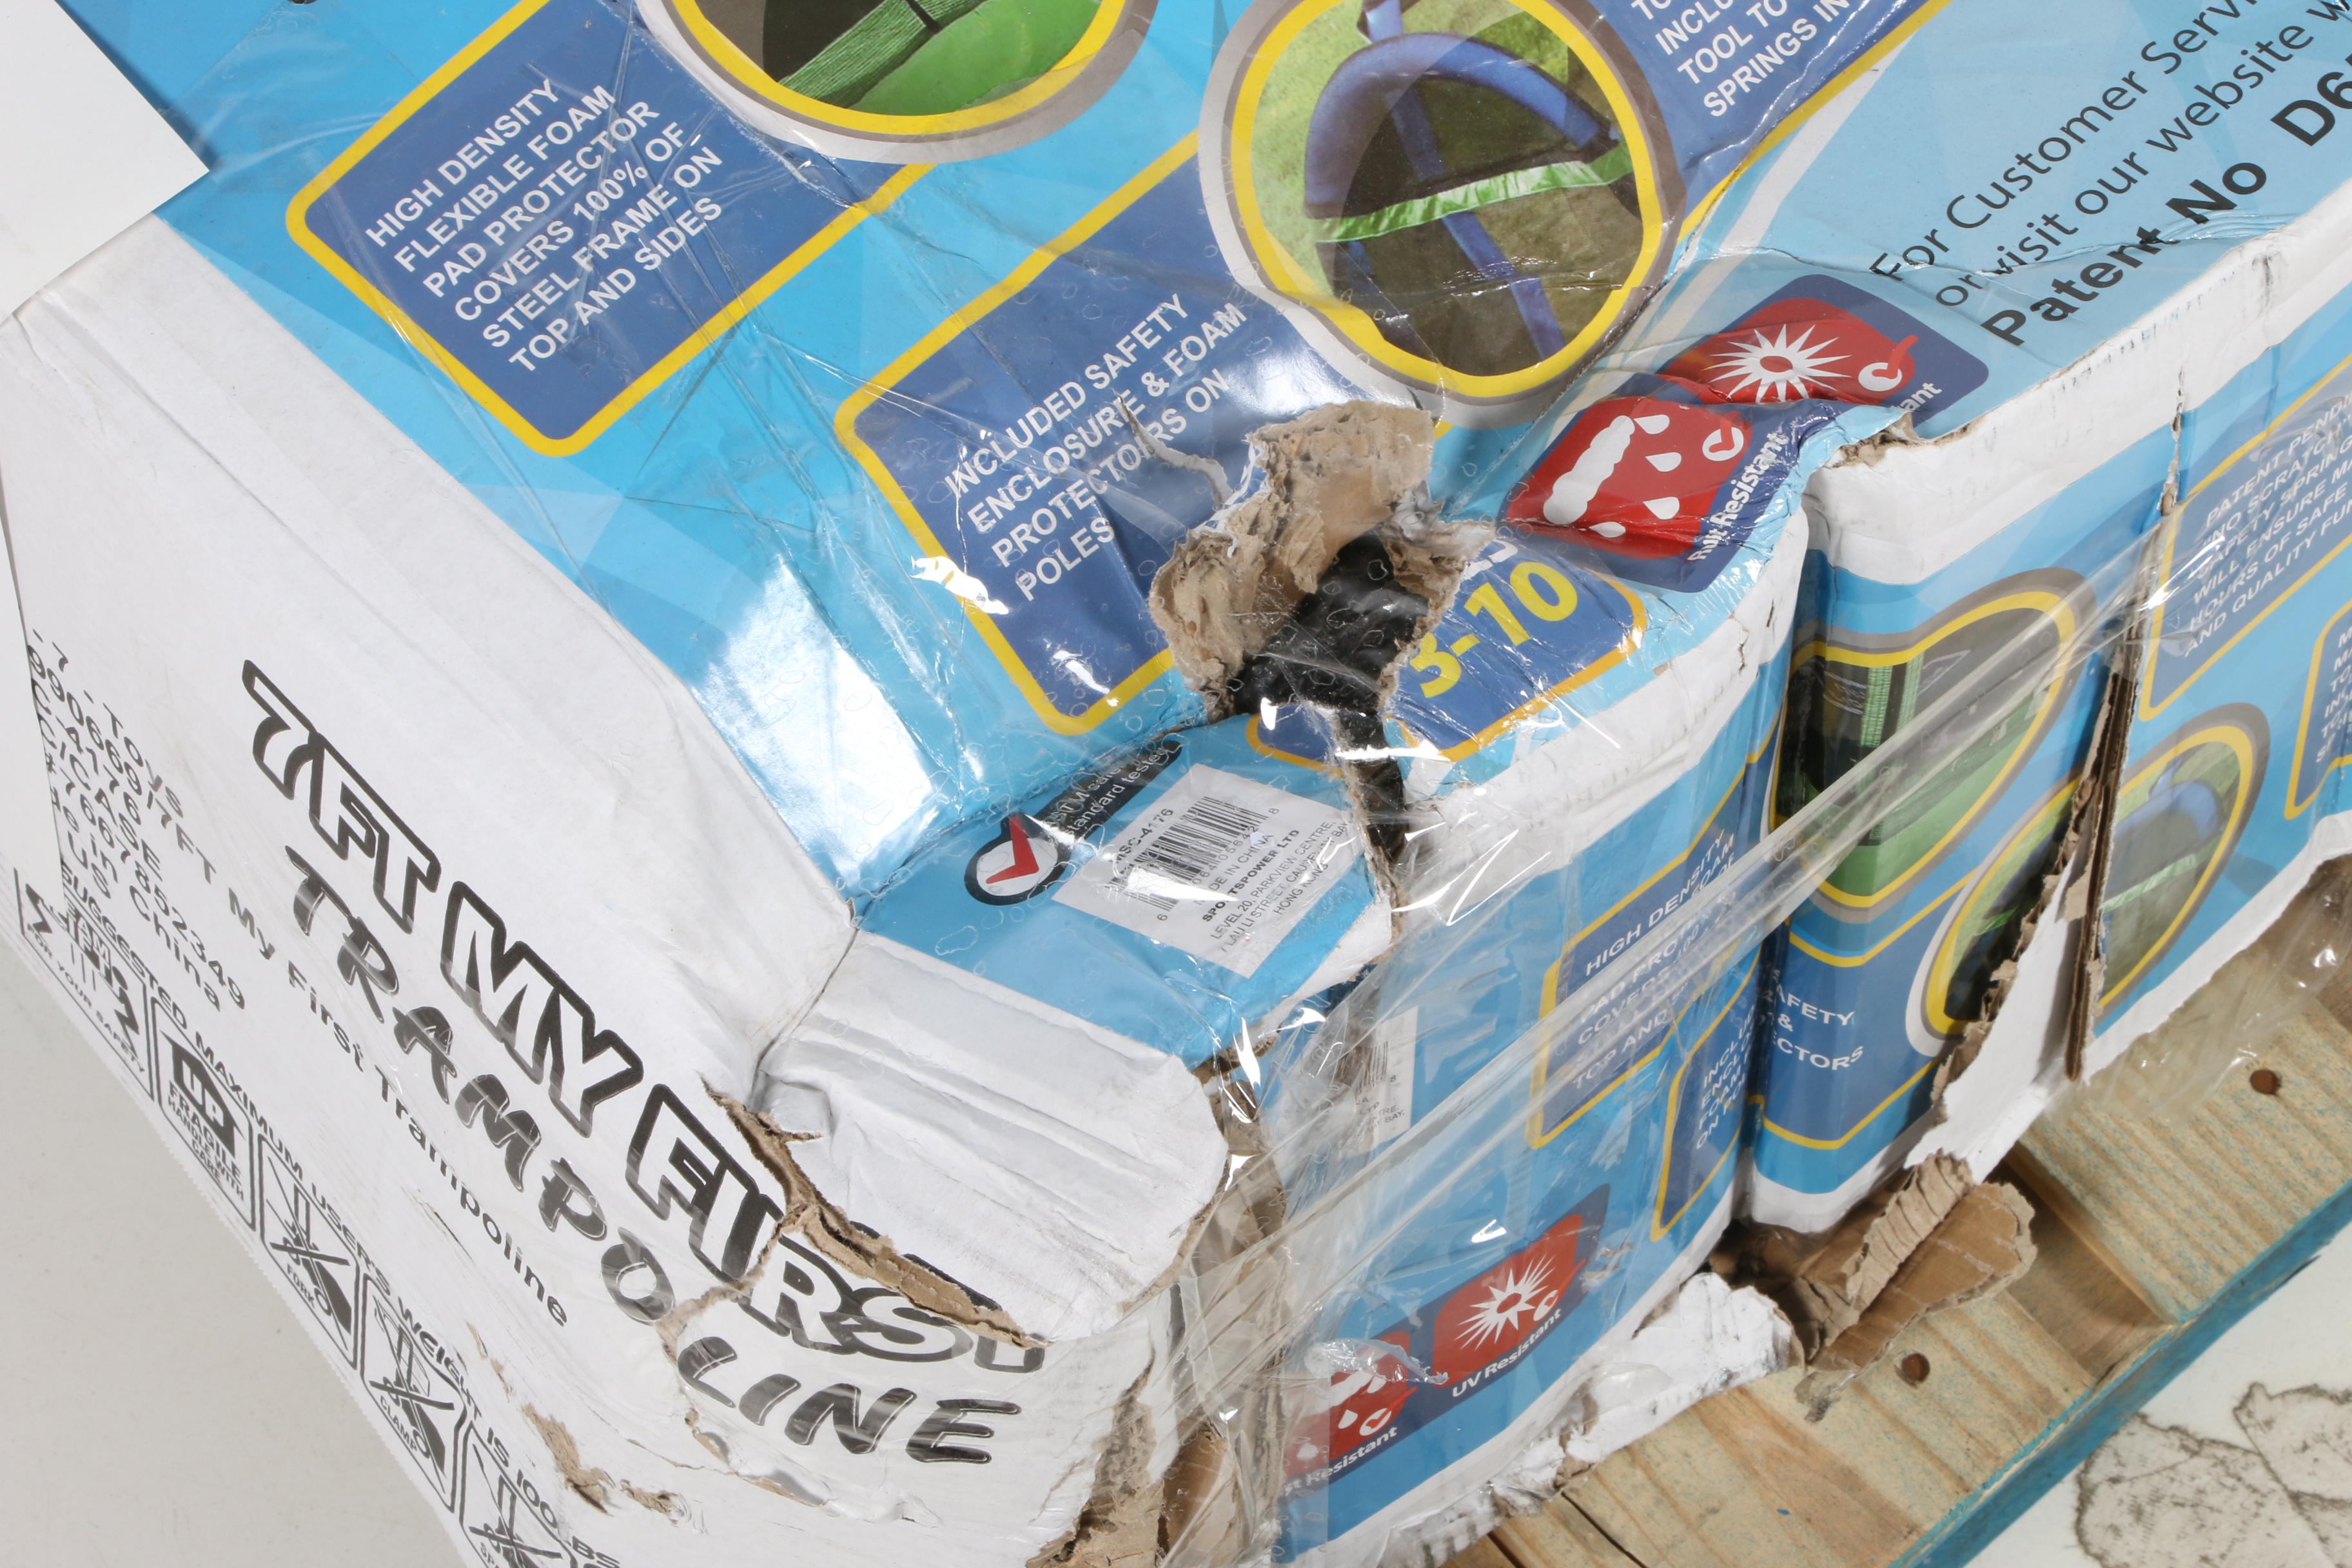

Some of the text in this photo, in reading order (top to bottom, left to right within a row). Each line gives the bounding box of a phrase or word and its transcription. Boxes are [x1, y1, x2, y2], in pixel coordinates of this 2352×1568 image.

[1677, 0, 1787, 84] TOOL TO
[1703, 19, 1817, 116] SPRINGS
[366, 79, 559, 246] HIGH DENSITY
[394, 85, 616, 272] FLEXIBLE FOAM
[423, 101, 660, 298] PAD PROTECTOR
[1870, 0, 2257, 281] For Customer Serv
[1936, 270, 1988, 307] or
[1988, 213, 2079, 274] visit
[2075, 152, 2149, 215] our
[2146, 26, 2314, 153] website
[1980, 54, 2352, 346] Patent No D6
[455, 122, 687, 321] COVERS 100% OF
[483, 146, 723, 348] STEEL FRAME ON
[509, 197, 722, 371] TOP AND SIDES
[945, 293, 1188, 498] INCLUDED SAFETY
[968, 302, 1247, 532] ENCLOSURE & FOAM
[992, 368, 1230, 567] PROTECTORS ON
[1710, 426, 1789, 526] Resistant
[2206, 450, 2285, 527] PATENT
[1015, 517, 1115, 602] POLES
[2185, 612, 2226, 658] AND
[2232, 530, 2317, 613] QUALITY
[2190, 482, 2347, 631] HOURS OF SAFE
[2194, 560, 2240, 605] WILL
[2247, 479, 2327, 559] ENSURE
[2198, 502, 2276, 580] SAFETY
[1410, 562, 1578, 698] 3-10
[52, 641, 69, 673] 7
[103, 702, 184, 819] Toys
[67, 830, 112, 899] US
[1064, 784, 1126, 838] standard
[1224, 864, 1240, 876] IN
[1238, 834, 1274, 864] CHINA
[89, 832, 119, 884] in
[129, 885, 221, 1012] China
[1202, 830, 1300, 922] SPOTSPOWER LTD
[1210, 912, 1243, 939] LEVEL
[1250, 855, 1297, 898] PARKVIEW
[1241, 917, 1255, 927] LI
[1250, 882, 1288, 918] STREET
[1273, 888, 1303, 915] HONG
[1585, 923, 1642, 977] HIGH
[1648, 828, 1725, 928] DENSITY
[27, 923, 146, 1073] FOR YOUR SAFETY
[242, 659, 1046, 1372] 7FT MY FIRS
[1773, 1032, 1864, 1071] CTORS
[1778, 1013, 1794, 1032] &
[168, 1079, 242, 1186] FRAGILE
[168, 1094, 244, 1202] HANDLE WITH
[191, 1139, 221, 1186] CARE
[228, 887, 277, 961] My
[288, 959, 364, 1072] First
[374, 1063, 568, 1328] Trampoline
[61, 856, 188, 1030] SUGGESTED
[195, 1030, 304, 1181] MAXIMUM
[397, 1296, 483, 1420] WEIGHT
[487, 1426, 510, 1468] IS
[516, 1468, 558, 1529] 100
[565, 1534, 621, 1568] BS
[286, 1263, 316, 1309] FORK
[1451, 1307, 1562, 1399] UV Resistant
[379, 1396, 417, 1451] CLAMP
[1306, 1426, 1398, 1487] Resistant
